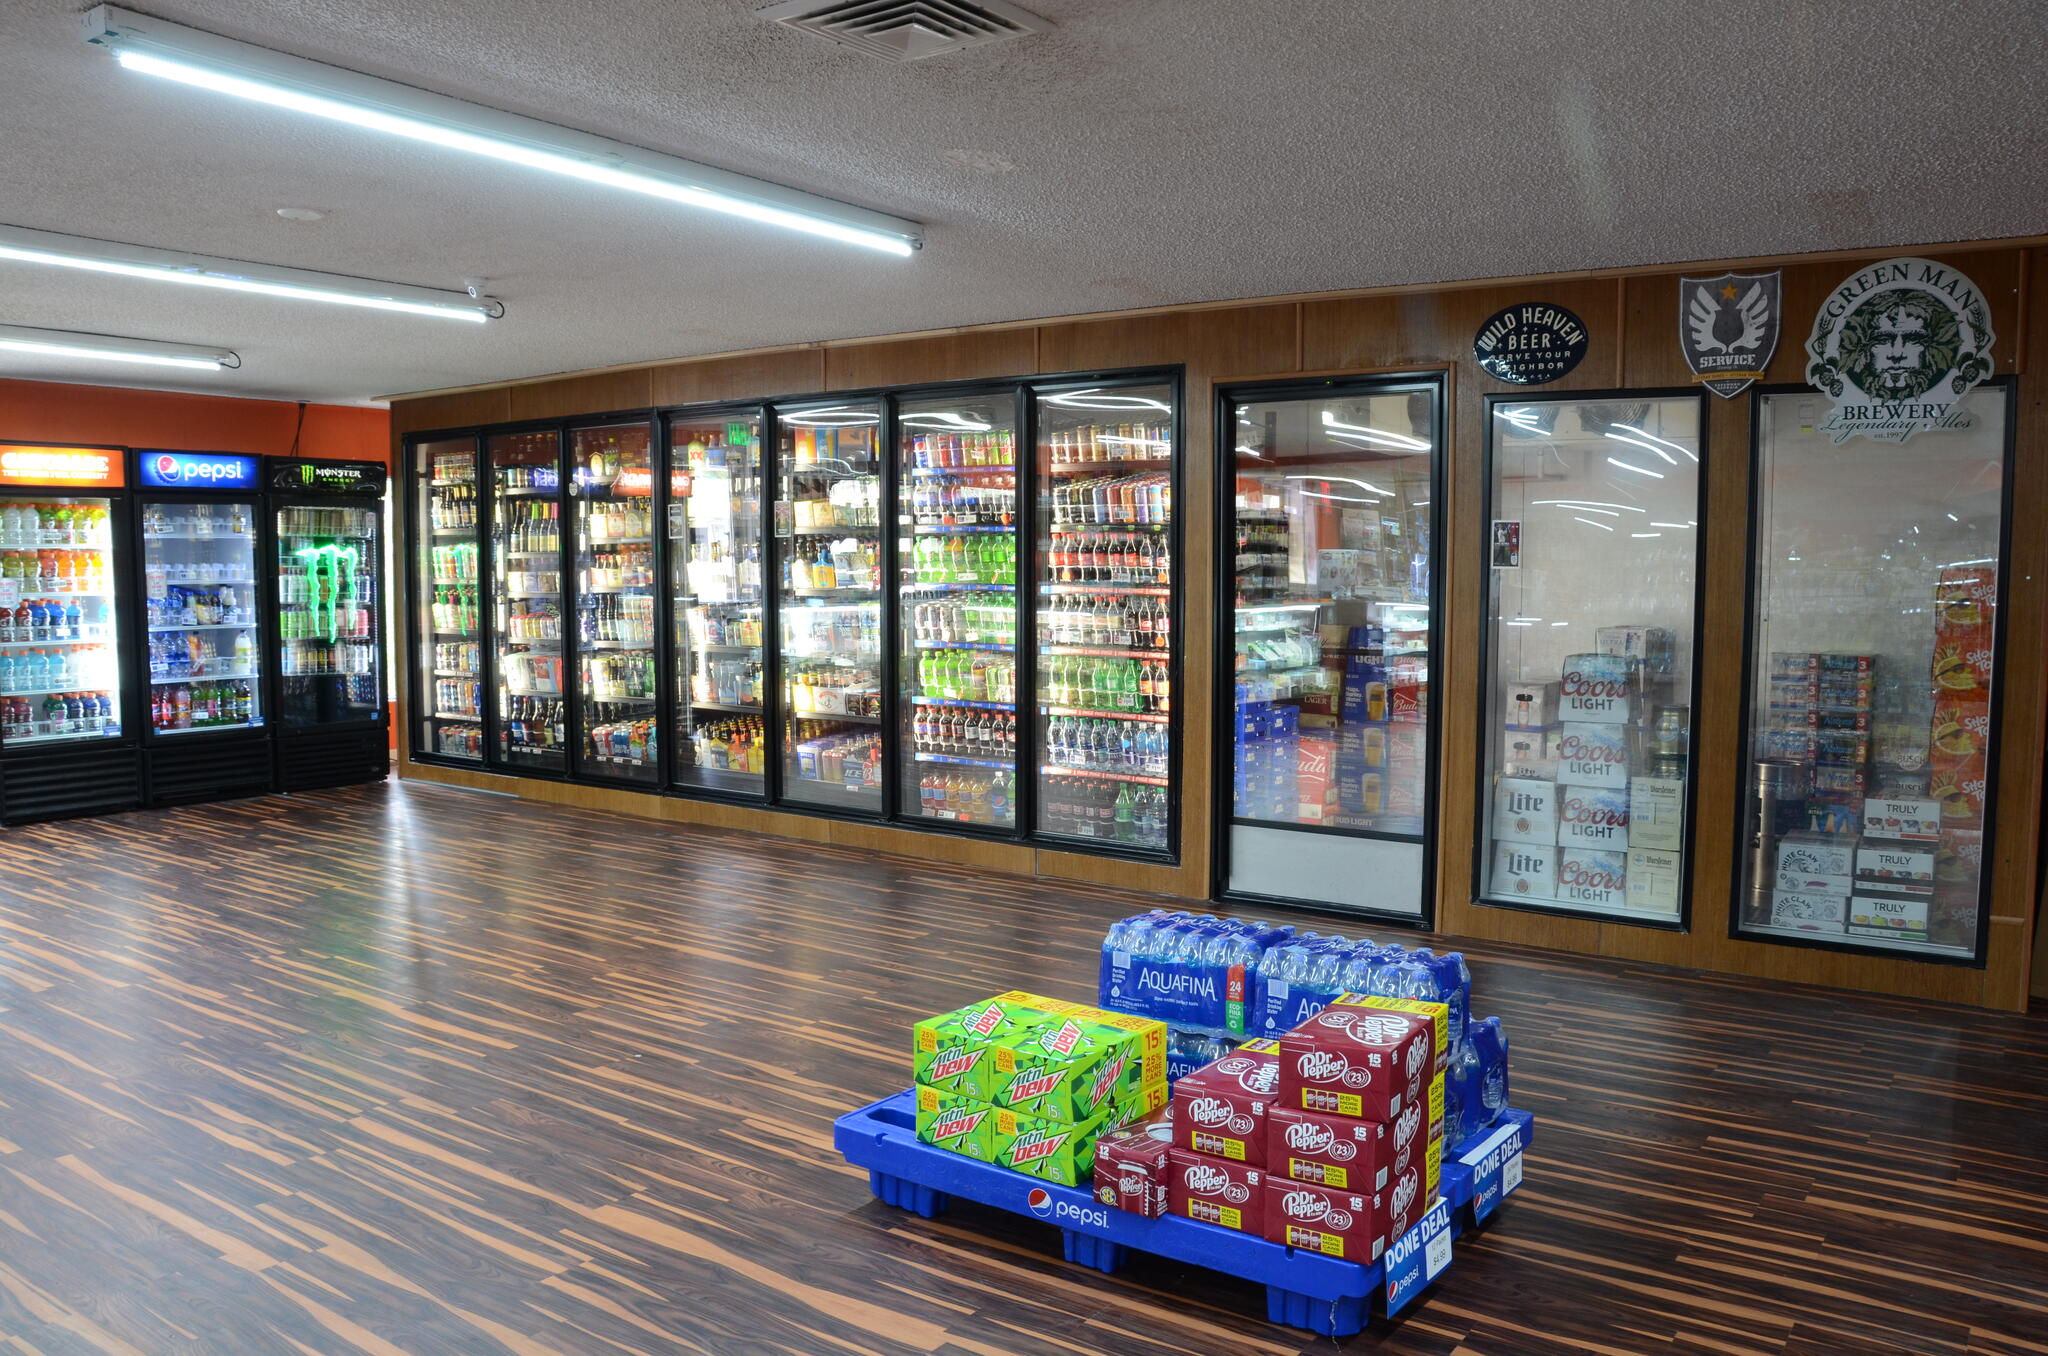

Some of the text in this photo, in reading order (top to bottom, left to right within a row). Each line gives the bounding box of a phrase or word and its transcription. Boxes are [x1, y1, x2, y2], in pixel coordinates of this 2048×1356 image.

[1827, 264, 1979, 318] GREEN MAN
[1478, 307, 1584, 351] WILD HEAVEN
[1508, 333, 1551, 350] BEER
[1489, 353, 1530, 362] SERVE
[1700, 354, 1756, 368] SERVICE
[1842, 404, 1951, 420] BREWERY
[1820, 412, 1972, 443] Legendary Ales
[184, 461, 243, 482] pepsi
[316, 467, 361, 478] MONSTER
[1809, 659, 1816, 667] 3
[1860, 661, 1867, 669] 3
[1560, 671, 1629, 698] Coors
[1809, 687, 1816, 695] 3
[1858, 690, 1866, 698] 3
[1571, 698, 1614, 711] LIGHT
[1809, 714, 1816, 722] 3
[1858, 718, 1865, 726] 3
[1559, 735, 1627, 763] Coors
[1808, 742, 1815, 750] 3
[1857, 746, 1865, 755] 3
[1570, 762, 1612, 776] LIGHT
[1856, 774, 1863, 782] 3
[1507, 791, 1544, 815] Lite
[1886, 804, 1919, 814] TRULY
[1561, 798, 1629, 827] Coors
[1572, 825, 1614, 839] LIGHT
[1507, 852, 1543, 876] Lite
[1781, 852, 1796, 871] WHITE
[1796, 850, 1818, 863] CLAW
[1878, 854, 1911, 865] TRULY
[1559, 860, 1627, 891] Coors
[1569, 888, 1611, 902] LIGHT
[1775, 896, 1812, 916] WHITE CLAW
[1873, 902, 1906, 912] TRULY
[1138, 967, 1216, 1001] AQUAFINA
[1229, 981, 1241, 992] 24
[1145, 1031, 1159, 1050] 15
[1146, 1054, 1162, 1065] 25%
[1317, 1052, 1332, 1064] Dr
[1368, 1053, 1381, 1064] 15
[1303, 1053, 1345, 1079] Pepper
[1351, 1072, 1361, 1083] 23
[966, 1082, 976, 1095] 15
[1147, 1090, 1160, 1109] 15
[1204, 1097, 1220, 1111] Dr
[1251, 1101, 1264, 1112] 15
[1047, 1104, 1058, 1118] 15
[1193, 1099, 1231, 1124] Pepper
[1235, 1119, 1246, 1129] 23
[1303, 1122, 1319, 1136] Dr
[1290, 1125, 1330, 1150] Pepper
[1354, 1126, 1367, 1138] 15
[968, 1142, 979, 1156] 15
[1100, 1145, 1109, 1156] 12
[1337, 1145, 1347, 1156] 23
[1474, 1131, 1522, 1184] DONE DEAL
[1049, 1166, 1060, 1180] 15
[1200, 1165, 1216, 1177] Dr
[1246, 1171, 1259, 1182] 15
[1190, 1167, 1225, 1191] Pepper
[1231, 1188, 1241, 1198] 23
[1298, 1191, 1316, 1204] Dr
[1482, 1184, 1498, 1204] pepsi
[1287, 1193, 1327, 1218] Pepper
[1349, 1196, 1363, 1208] 15
[1056, 1201, 1109, 1229] pepsi
[1333, 1214, 1343, 1225] 23
[1385, 1227, 1420, 1272] DONE
[1421, 1204, 1450, 1243] DEAL
[1398, 1265, 1419, 1293] pepsi
